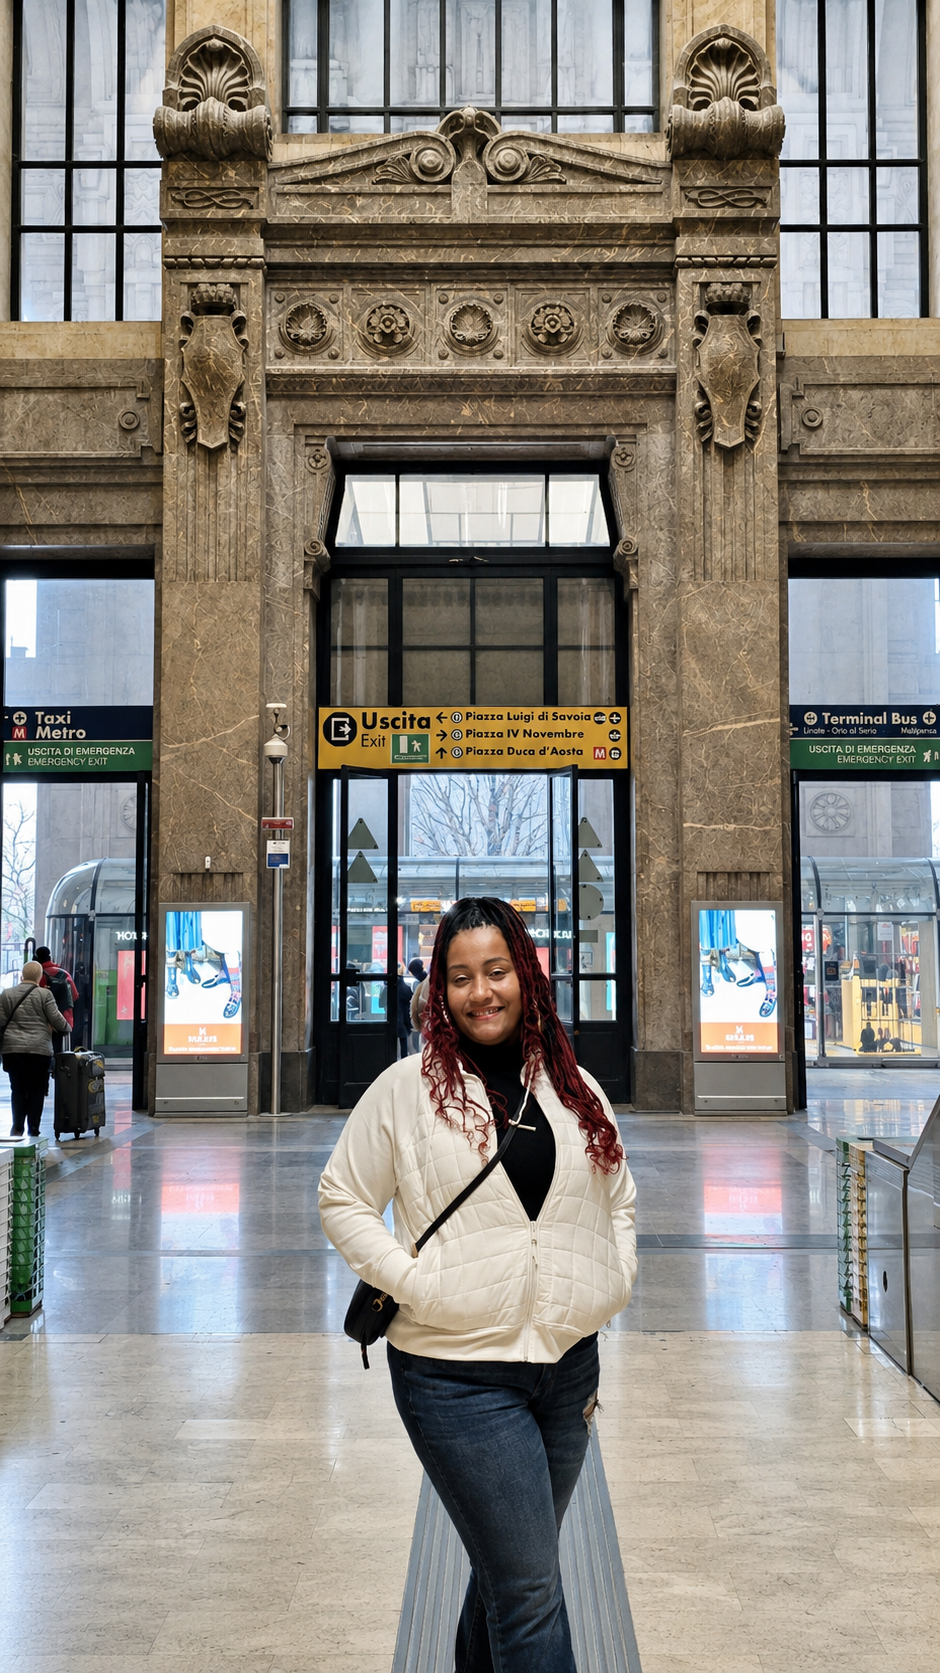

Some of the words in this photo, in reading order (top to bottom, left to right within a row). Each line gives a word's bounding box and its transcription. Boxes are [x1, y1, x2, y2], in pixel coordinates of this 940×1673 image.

[35, 711, 71, 724] Taxi
[362, 711, 431, 730] Uscita
[466, 712, 504, 721] Piazza
[507, 711, 534, 723] Luigi
[538, 712, 548, 721] di
[552, 711, 591, 721] Savoia
[822, 712, 886, 724] Terminal
[892, 712, 918, 724] Bus
[14, 728, 25, 739] M
[36, 726, 86, 739] Metro
[466, 729, 504, 738] Piazza
[507, 729, 519, 738] IV
[522, 729, 584, 738] Novembre
[804, 726, 826, 734] Linate
[858, 726, 878, 734] Serio
[361, 734, 386, 748] Exit
[28, 747, 61, 756] USCITA
[64, 747, 73, 755] DI
[76, 747, 135, 755] EMERGENZA
[466, 747, 504, 756] Piazza
[507, 747, 535, 756] Duca
[594, 748, 606, 759] M
[28, 758, 86, 766] EMERGENCY
[88, 758, 108, 766] EXIT
[837, 756, 893, 764] EMERGENCY
